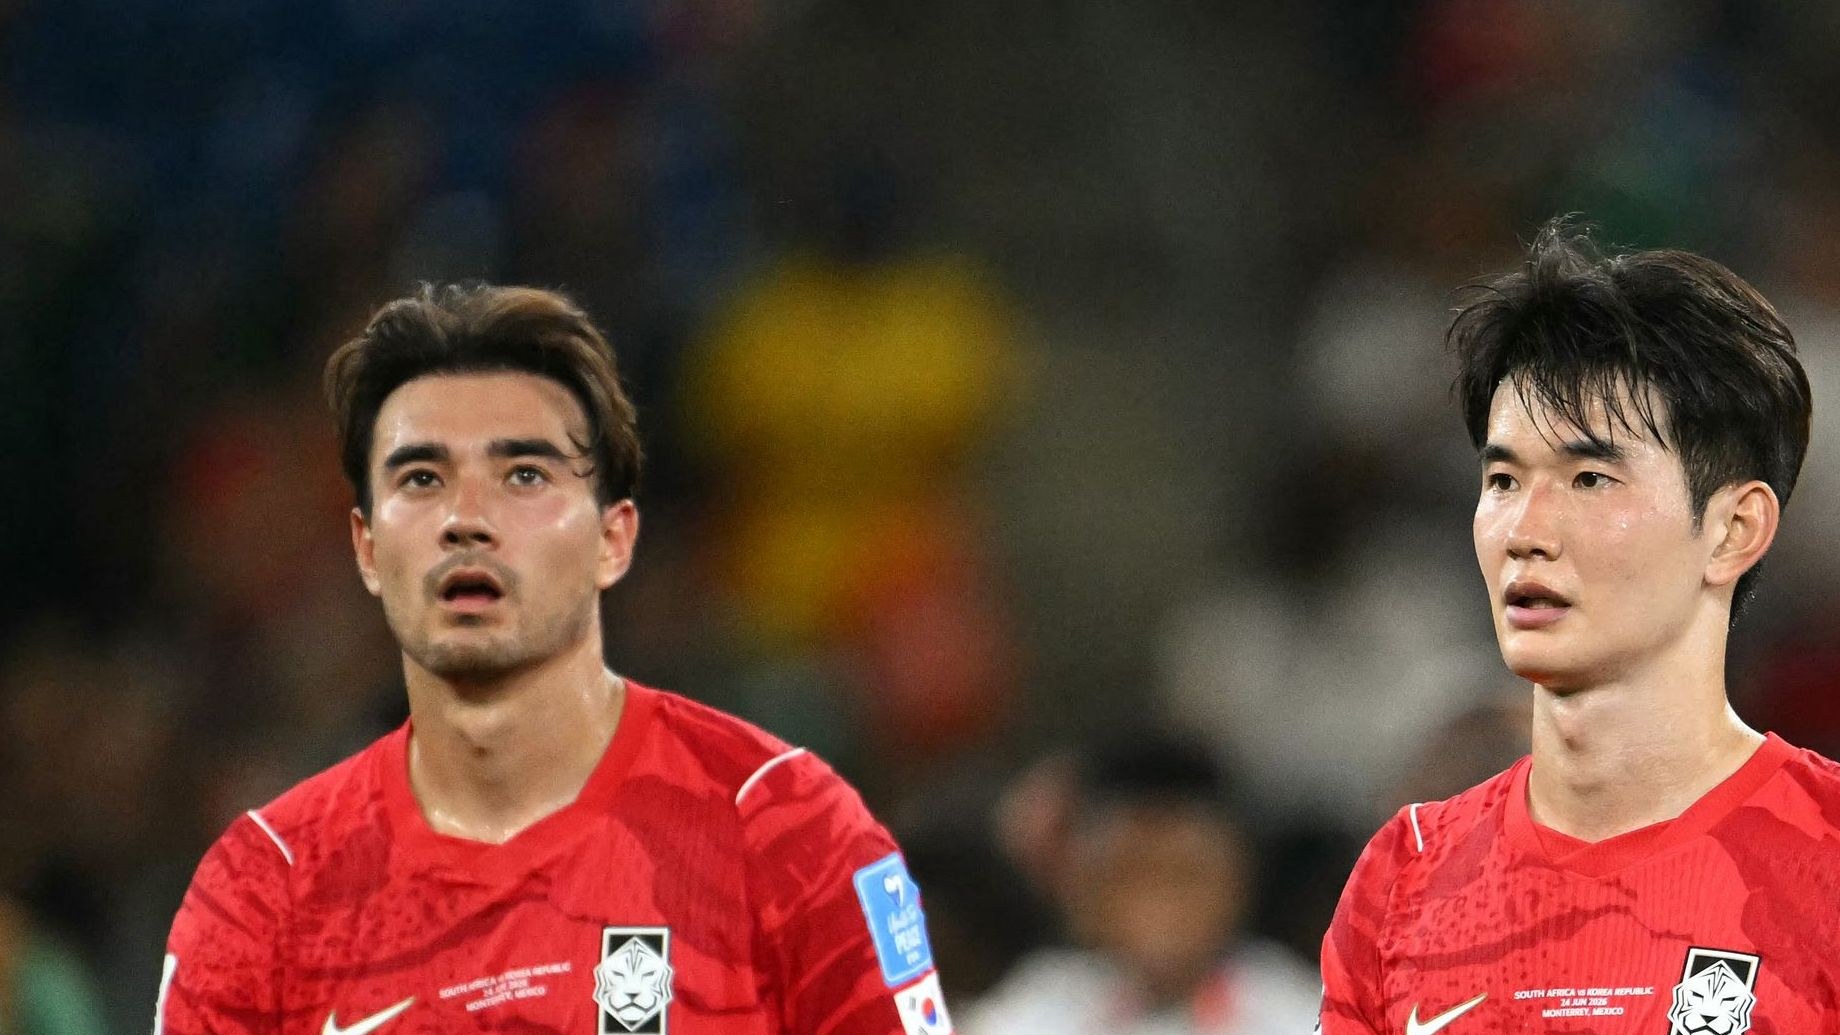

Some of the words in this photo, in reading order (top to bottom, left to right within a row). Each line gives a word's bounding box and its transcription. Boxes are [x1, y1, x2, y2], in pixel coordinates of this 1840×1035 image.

[1514, 990, 1545, 1000] SOUTH
[1546, 988, 1576, 998] AFRICA
[1587, 988, 1613, 997] KOREA
[1614, 986, 1655, 996] REPUBLIC
[1560, 999, 1571, 1007] 24
[1571, 998, 1588, 1007] JUN
[1588, 997, 1608, 1006] 2026
[1592, 1006, 1624, 1017] MEXICO
